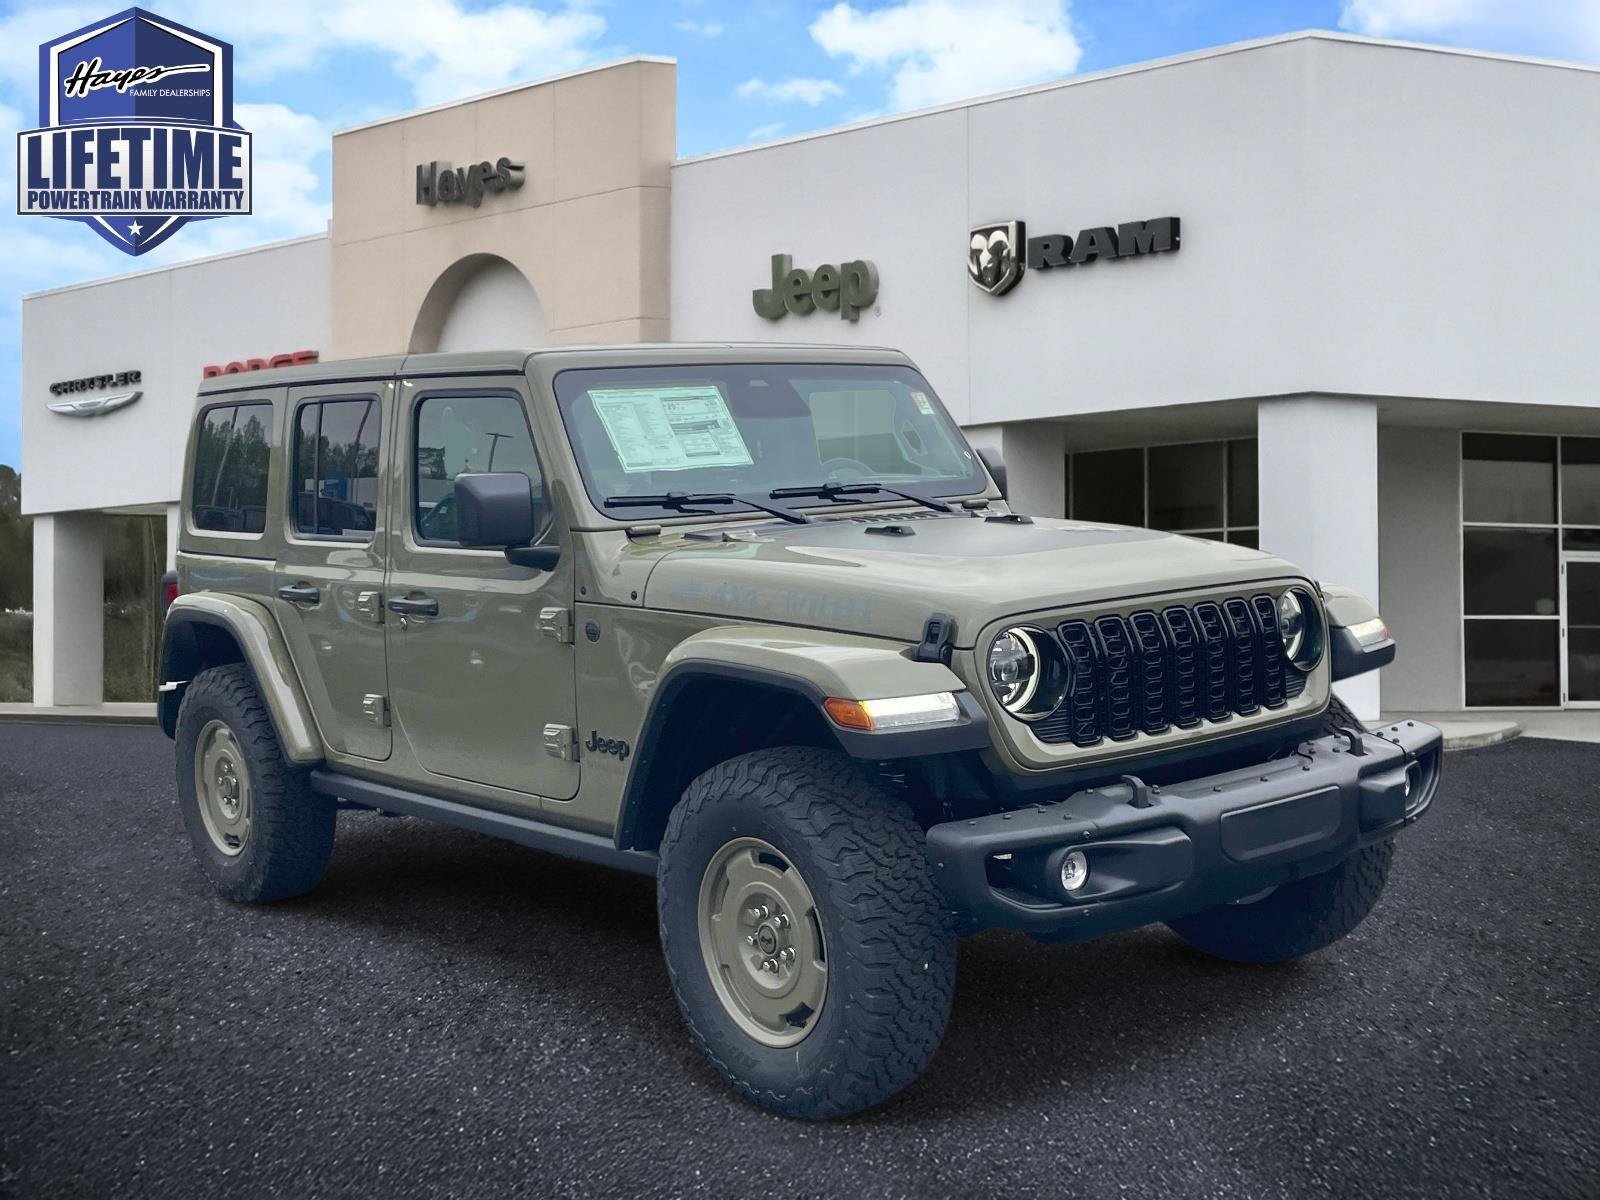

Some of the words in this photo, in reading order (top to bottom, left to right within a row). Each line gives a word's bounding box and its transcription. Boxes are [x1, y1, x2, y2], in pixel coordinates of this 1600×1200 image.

[416, 156, 525, 209] Hayes
[1028, 216, 1181, 270] RAM
[752, 253, 880, 322] Jeep
[585, 730, 630, 761] Jeep
